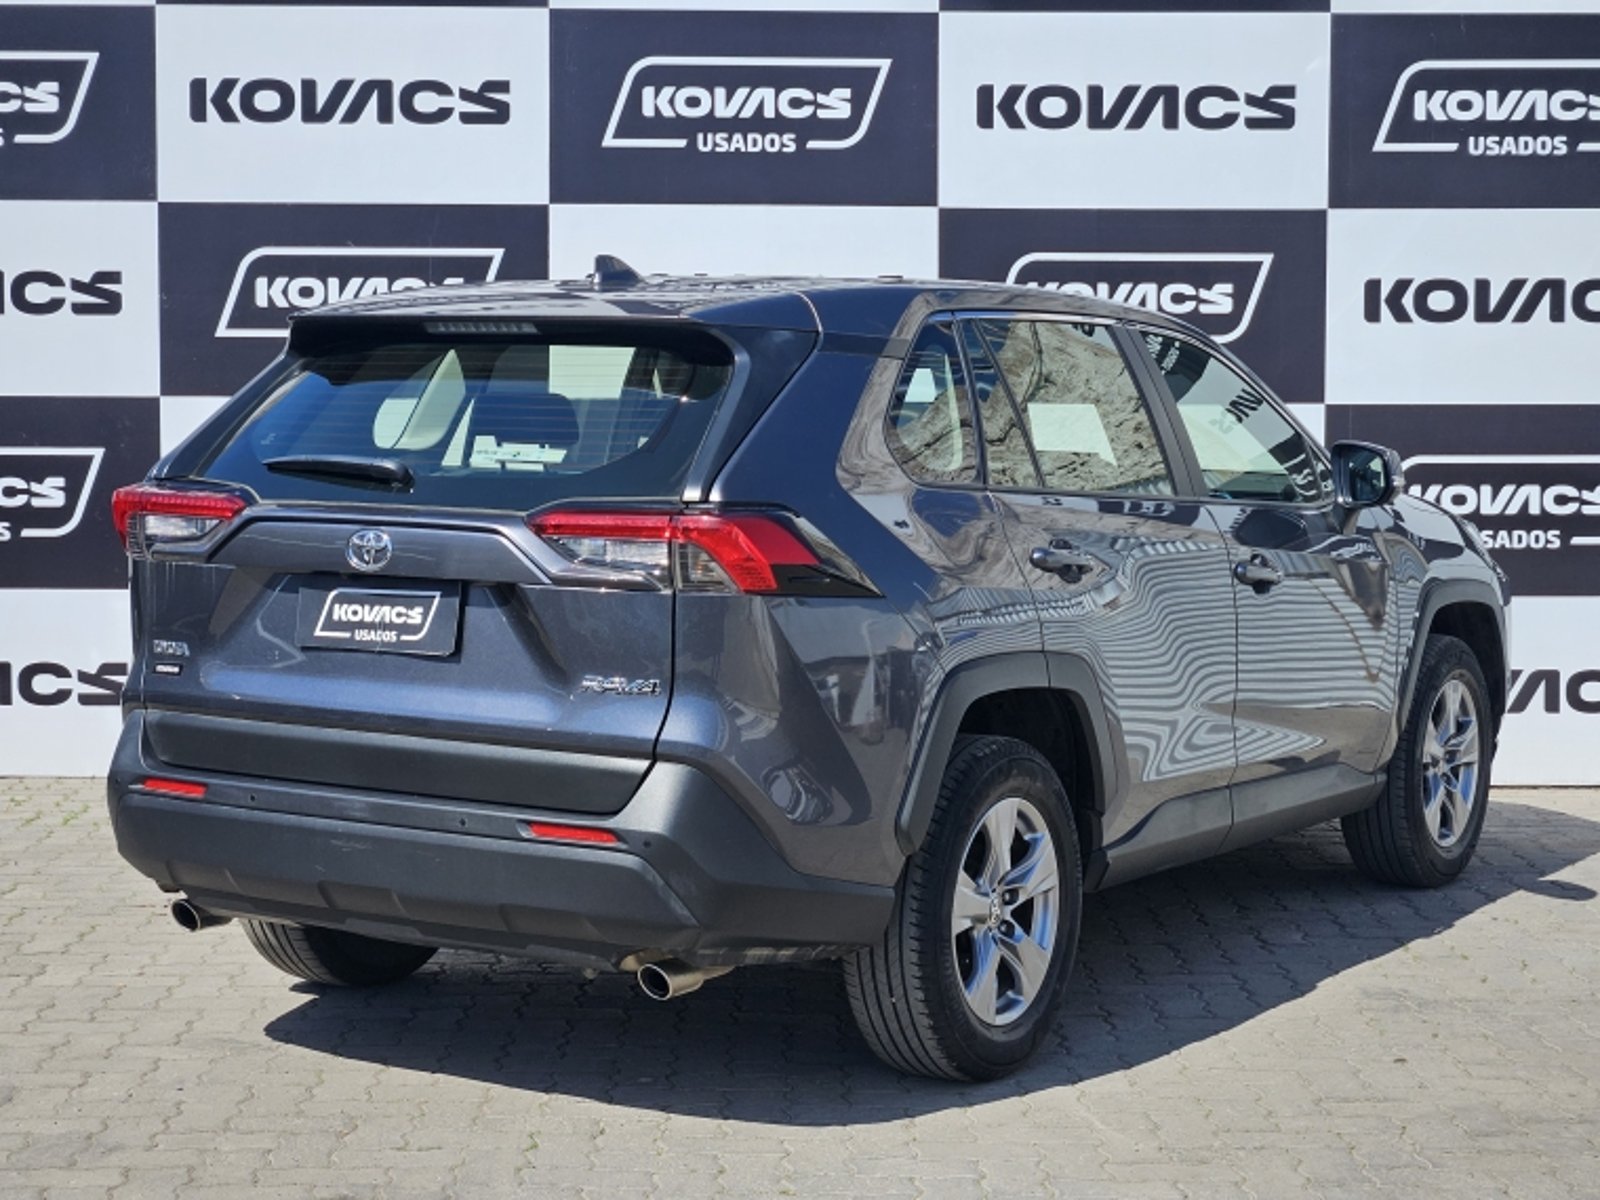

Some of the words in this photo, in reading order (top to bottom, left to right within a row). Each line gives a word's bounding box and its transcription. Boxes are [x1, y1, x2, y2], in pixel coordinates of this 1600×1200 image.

[189, 78, 510, 125] KOVACS
[642, 86, 852, 119] KOVACS
[976, 84, 1296, 130] KOVACS
[697, 133, 796, 153] USADOS
[1468, 136, 1567, 155] USADOS
[0, 271, 122, 316] CS
[1480, 530, 1561, 549] SADOS
[332, 604, 424, 624] KOVACS
